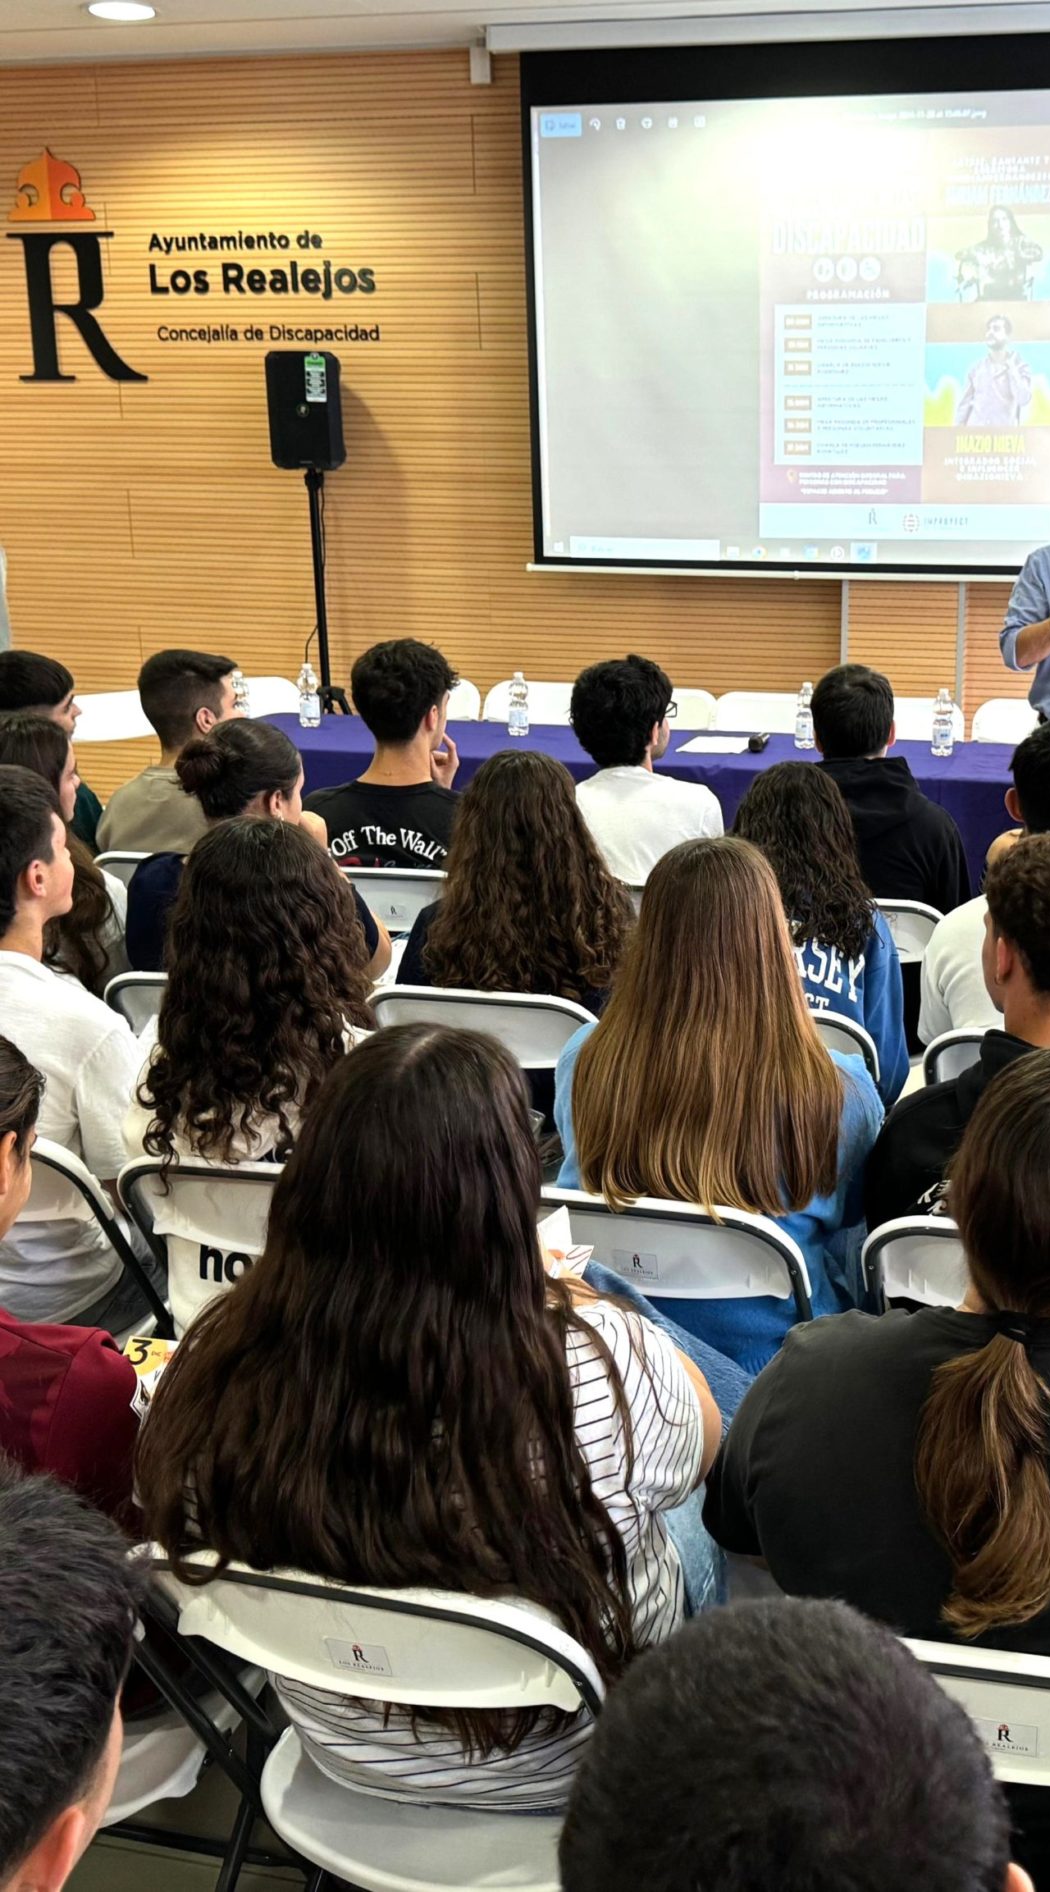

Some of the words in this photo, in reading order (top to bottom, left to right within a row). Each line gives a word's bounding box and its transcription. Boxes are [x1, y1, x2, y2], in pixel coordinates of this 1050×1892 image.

[149, 231, 291, 255] Ayuntamiento
[297, 230, 323, 250] de
[774, 218, 925, 253] DISCAPACIDAD
[149, 264, 210, 295] Los
[222, 261, 377, 300] Realejos
[157, 325, 238, 343] Concejalía
[243, 325, 265, 342] de
[269, 325, 381, 343] Discapacidad
[361, 825, 397, 846] The
[126, 1338, 153, 1366] 3
